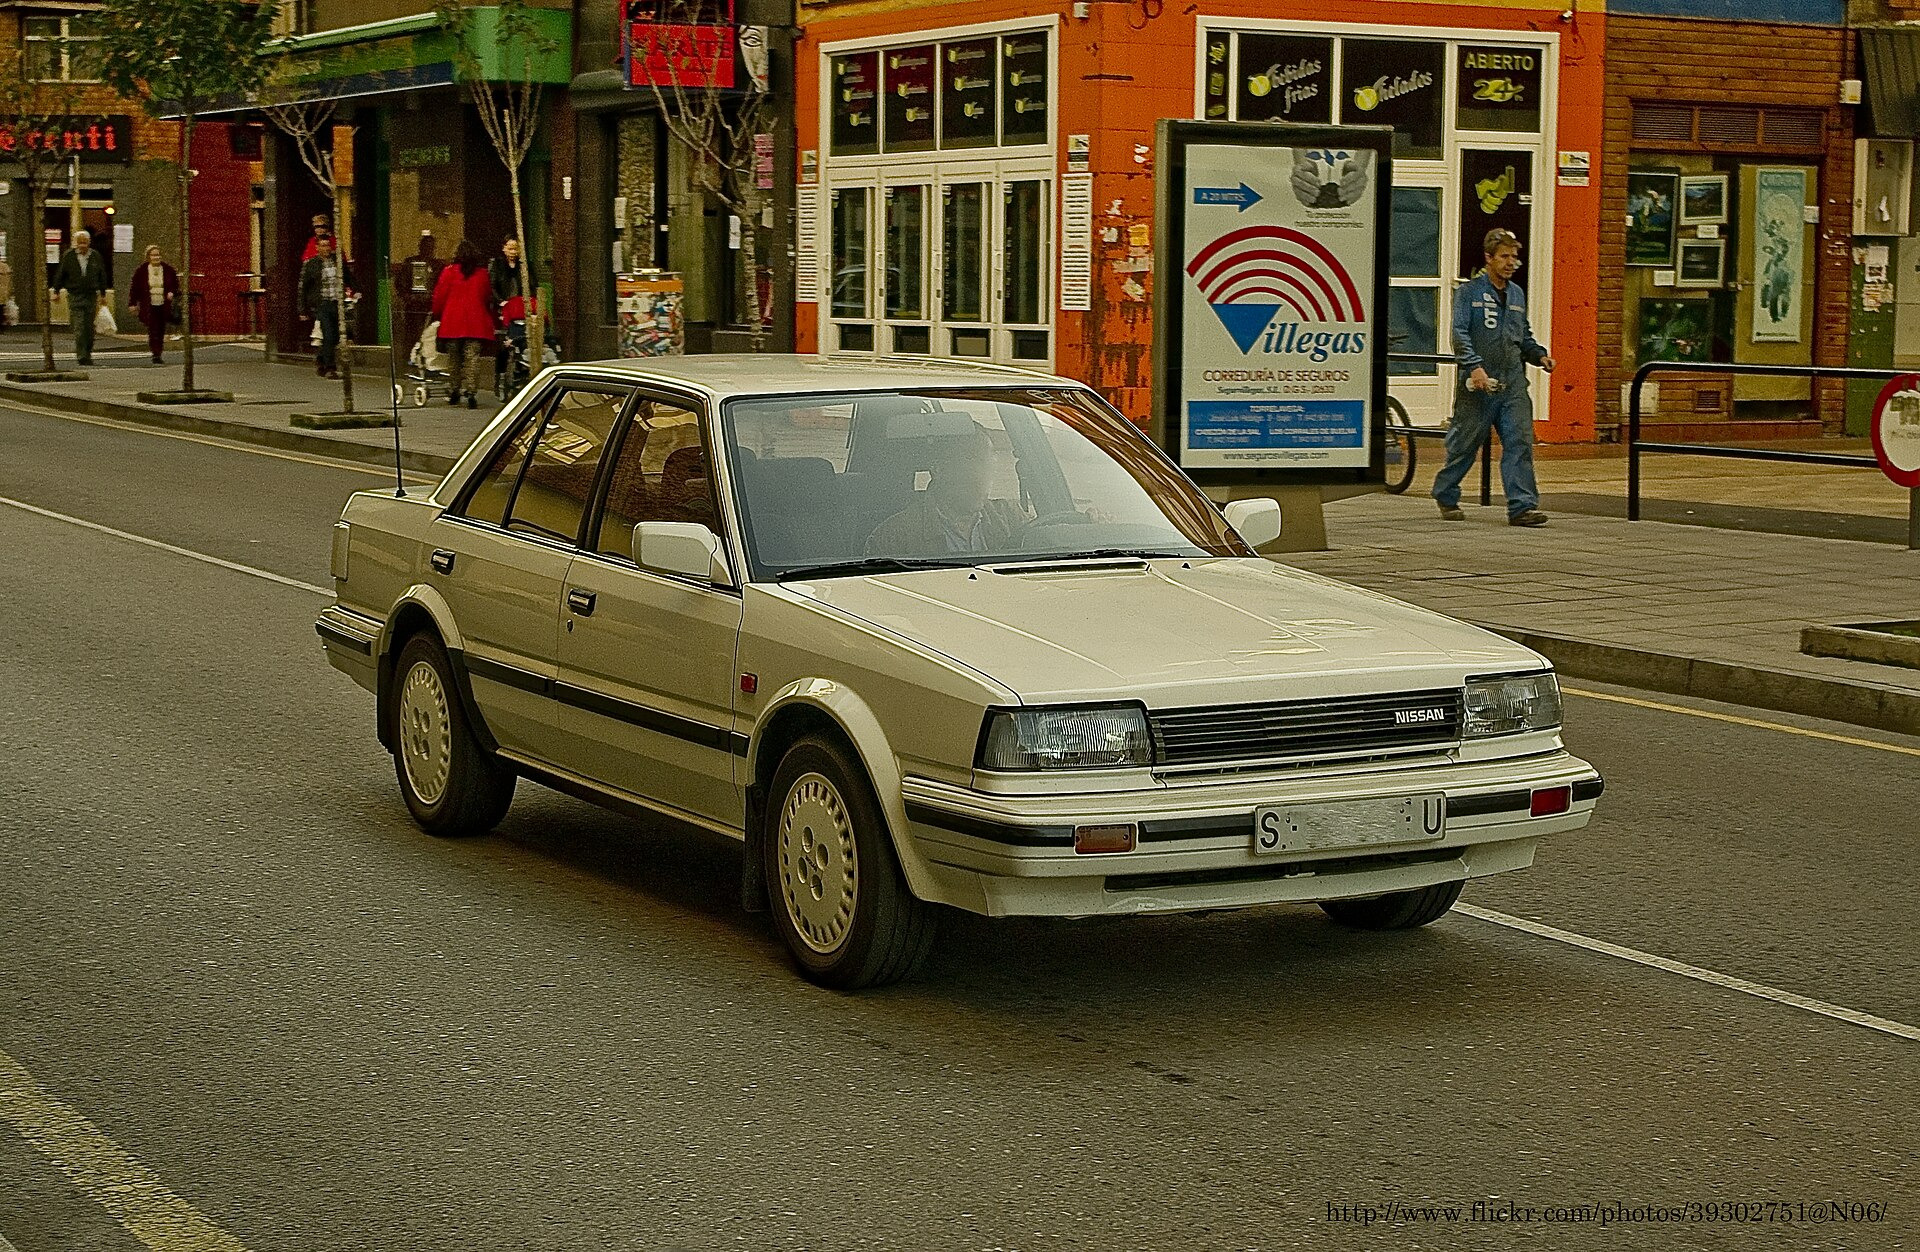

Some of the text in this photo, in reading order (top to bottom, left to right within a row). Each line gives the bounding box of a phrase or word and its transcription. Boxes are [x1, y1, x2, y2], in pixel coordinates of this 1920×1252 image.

[1464, 53, 1535, 71] ABIERTO
[1277, 370, 1293, 382] DE
[1295, 370, 1350, 382] SEGUROS
[1394, 708, 1445, 724] NISSAN
[1260, 798, 1443, 849] S U
